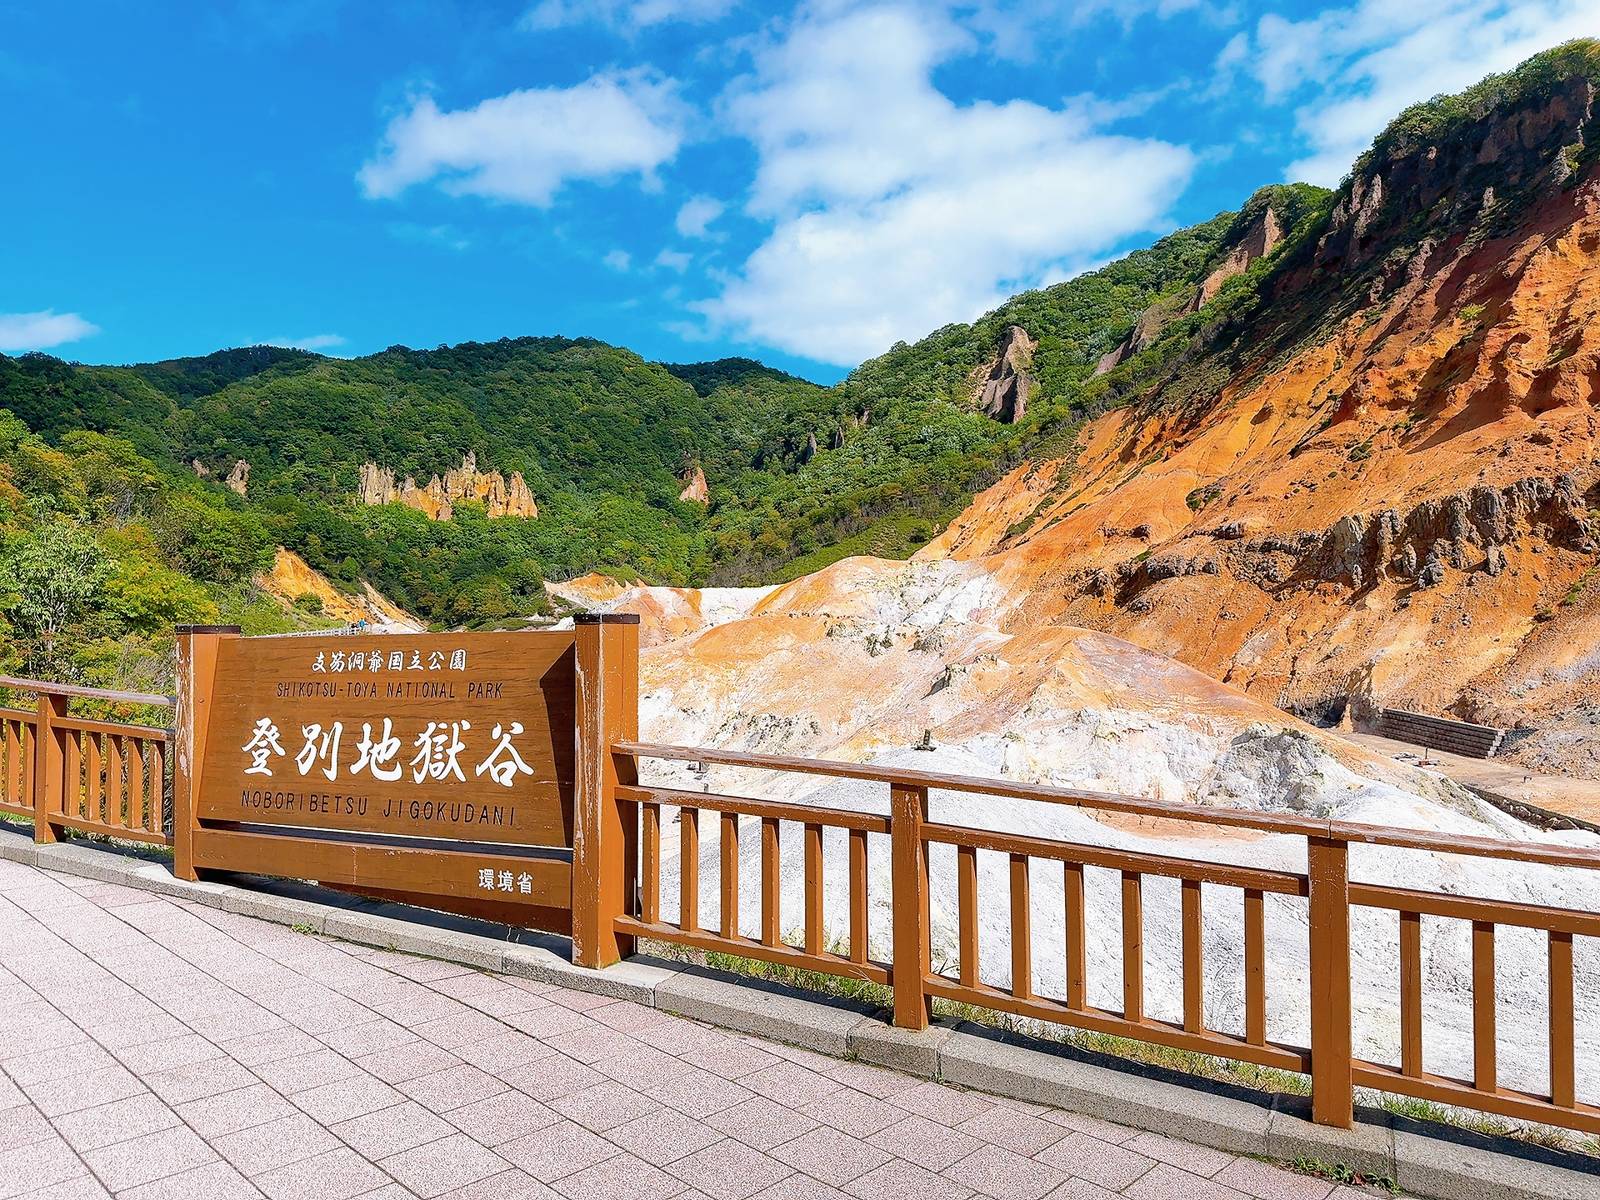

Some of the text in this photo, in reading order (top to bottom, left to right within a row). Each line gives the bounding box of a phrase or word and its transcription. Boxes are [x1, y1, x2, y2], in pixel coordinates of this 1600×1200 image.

[276, 681, 504, 699] SHIKOTSU-TOYA NATIONAL PARK
[241, 716, 535, 788] 登別地獄谷
[241, 790, 516, 827] NOBORIBETSU JIGOKUDANI
[478, 868, 534, 895] 環境省
